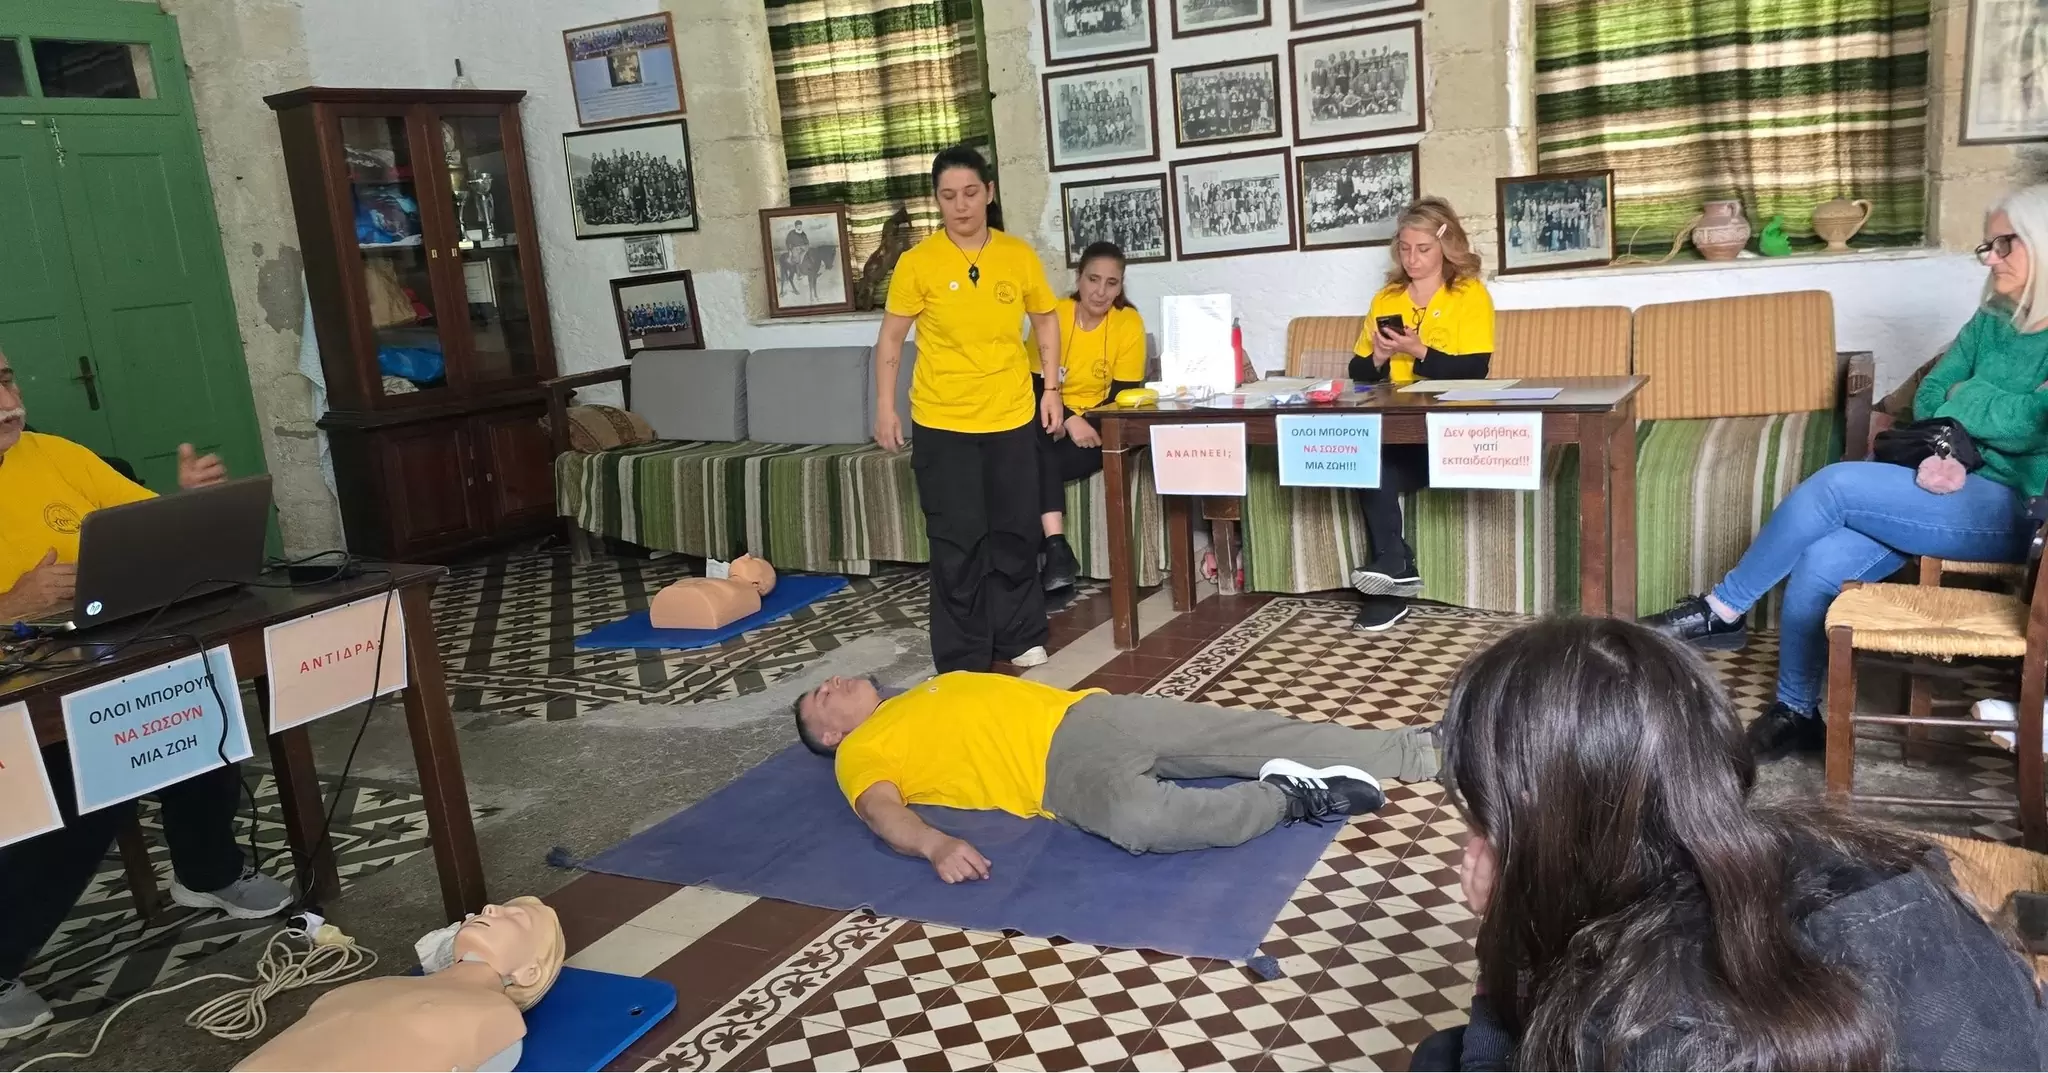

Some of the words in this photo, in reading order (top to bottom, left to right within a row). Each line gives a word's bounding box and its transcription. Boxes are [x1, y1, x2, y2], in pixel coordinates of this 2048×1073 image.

[1291, 428, 1316, 437] ΟΛΟΙ
[1318, 428, 1369, 437] ΜΠΟΡΟΥΝ
[1443, 427, 1464, 437] Δεν
[1467, 426, 1530, 439] φοβήθηκα,
[1303, 445, 1317, 453] ΝΑ
[1319, 445, 1358, 453] ΣΩΣΟΥΝ
[1473, 441, 1499, 453] γιατί
[1166, 449, 1232, 459] ΑΝΑΠΝΕΕΙ;
[1305, 461, 1324, 470] ΜΙΑ
[1326, 461, 1357, 471] ΖΩΗ!!!
[1442, 455, 1530, 468] εκπαιδεύτηκα!!!
[89, 700, 132, 725] ΟΛΟΙ
[113, 727, 139, 746] ΝΑ
[141, 705, 203, 737] ΣΩΣΟΥΝ
[130, 747, 164, 769] ΜΙΑ
[165, 734, 198, 756] ΖΩΗ
